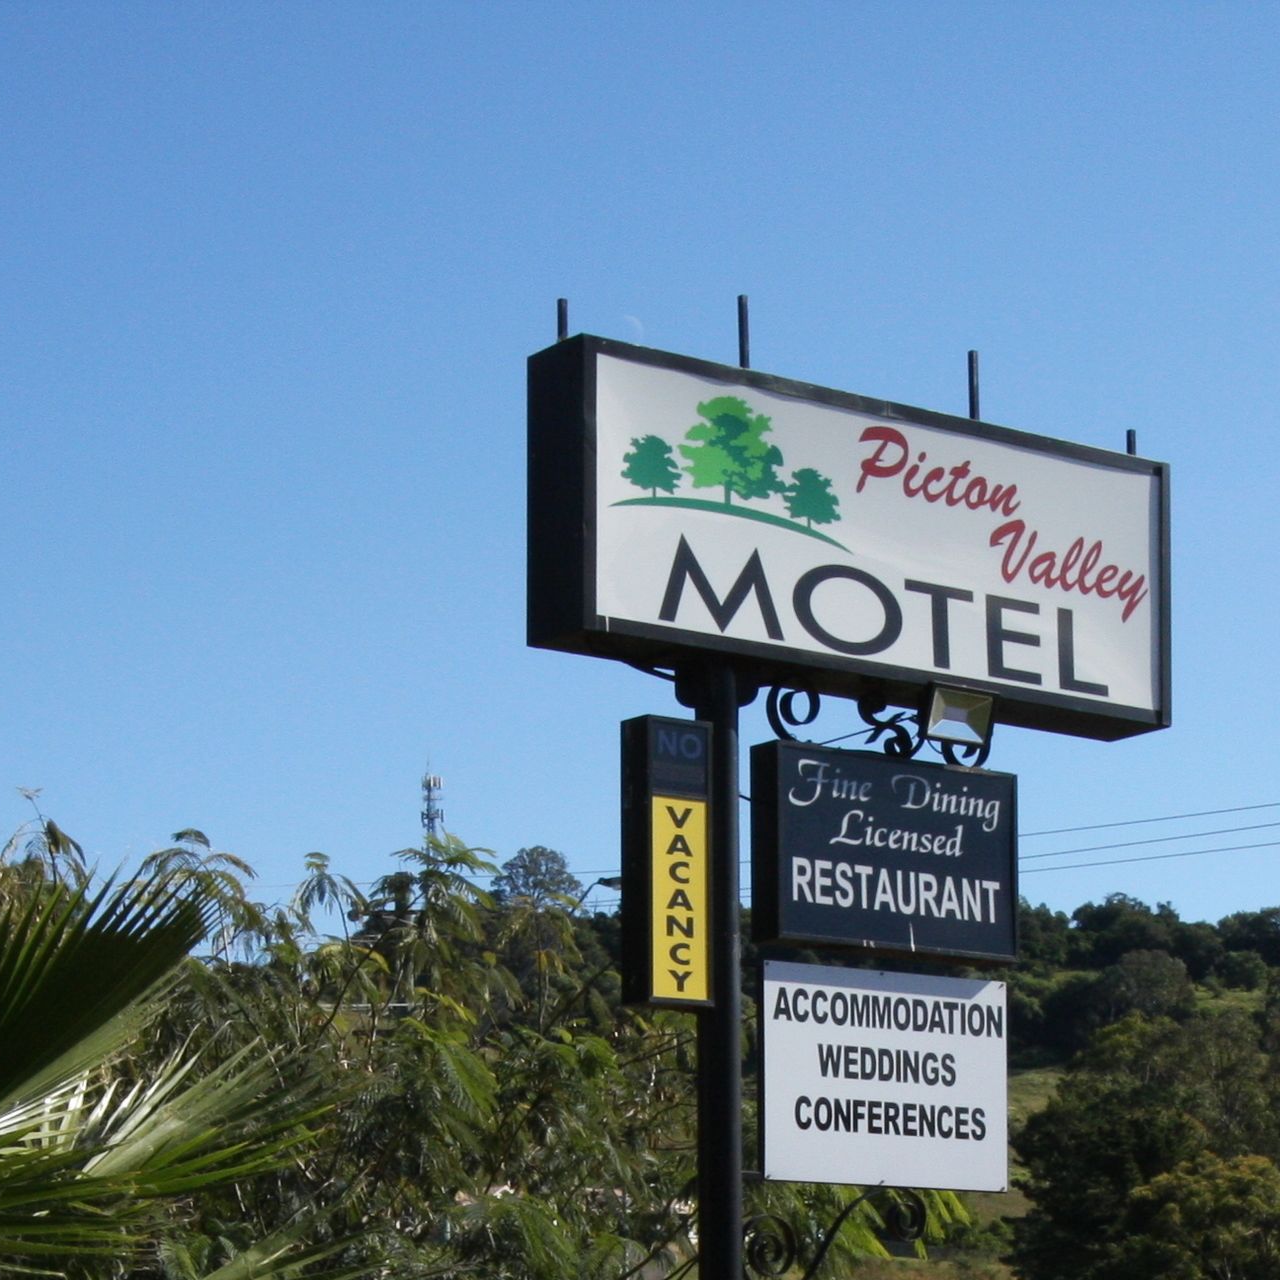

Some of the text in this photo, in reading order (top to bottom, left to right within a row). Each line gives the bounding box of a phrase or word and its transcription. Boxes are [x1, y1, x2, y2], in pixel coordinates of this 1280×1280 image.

[856, 425, 1020, 516] Picton
[989, 518, 1148, 623] Valley
[658, 533, 1109, 697] MOTEL
[656, 727, 703, 760] NO
[788, 759, 1001, 832] Fine Dining
[829, 810, 964, 858] Licensed
[665, 805, 695, 993] VACANCY
[791, 856, 1000, 924] RESTAURANT
[773, 987, 1004, 1039] ACCOMMODATION
[818, 1043, 957, 1087] WEDDINGS
[795, 1095, 987, 1141] CONFERENCES
